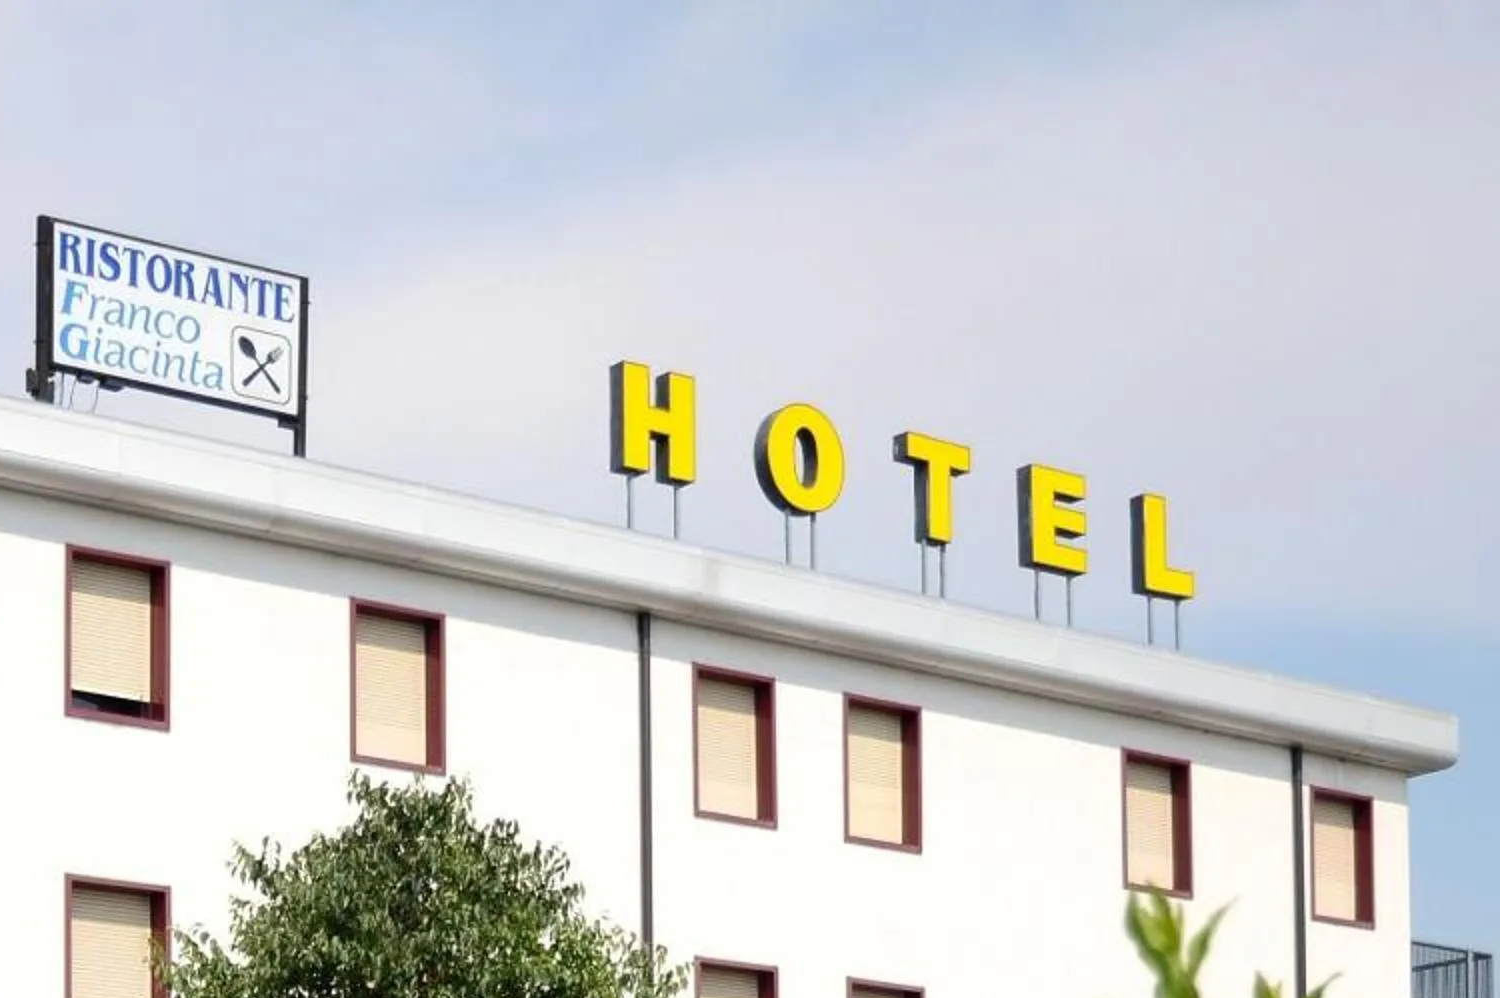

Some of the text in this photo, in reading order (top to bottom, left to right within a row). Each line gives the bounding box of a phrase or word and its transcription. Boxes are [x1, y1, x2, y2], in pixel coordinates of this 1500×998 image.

[57, 230, 295, 324] RISTORANTE
[60, 279, 202, 344] Franco
[58, 322, 224, 391] Giacinta
[609, 359, 1195, 601] HOTEL
